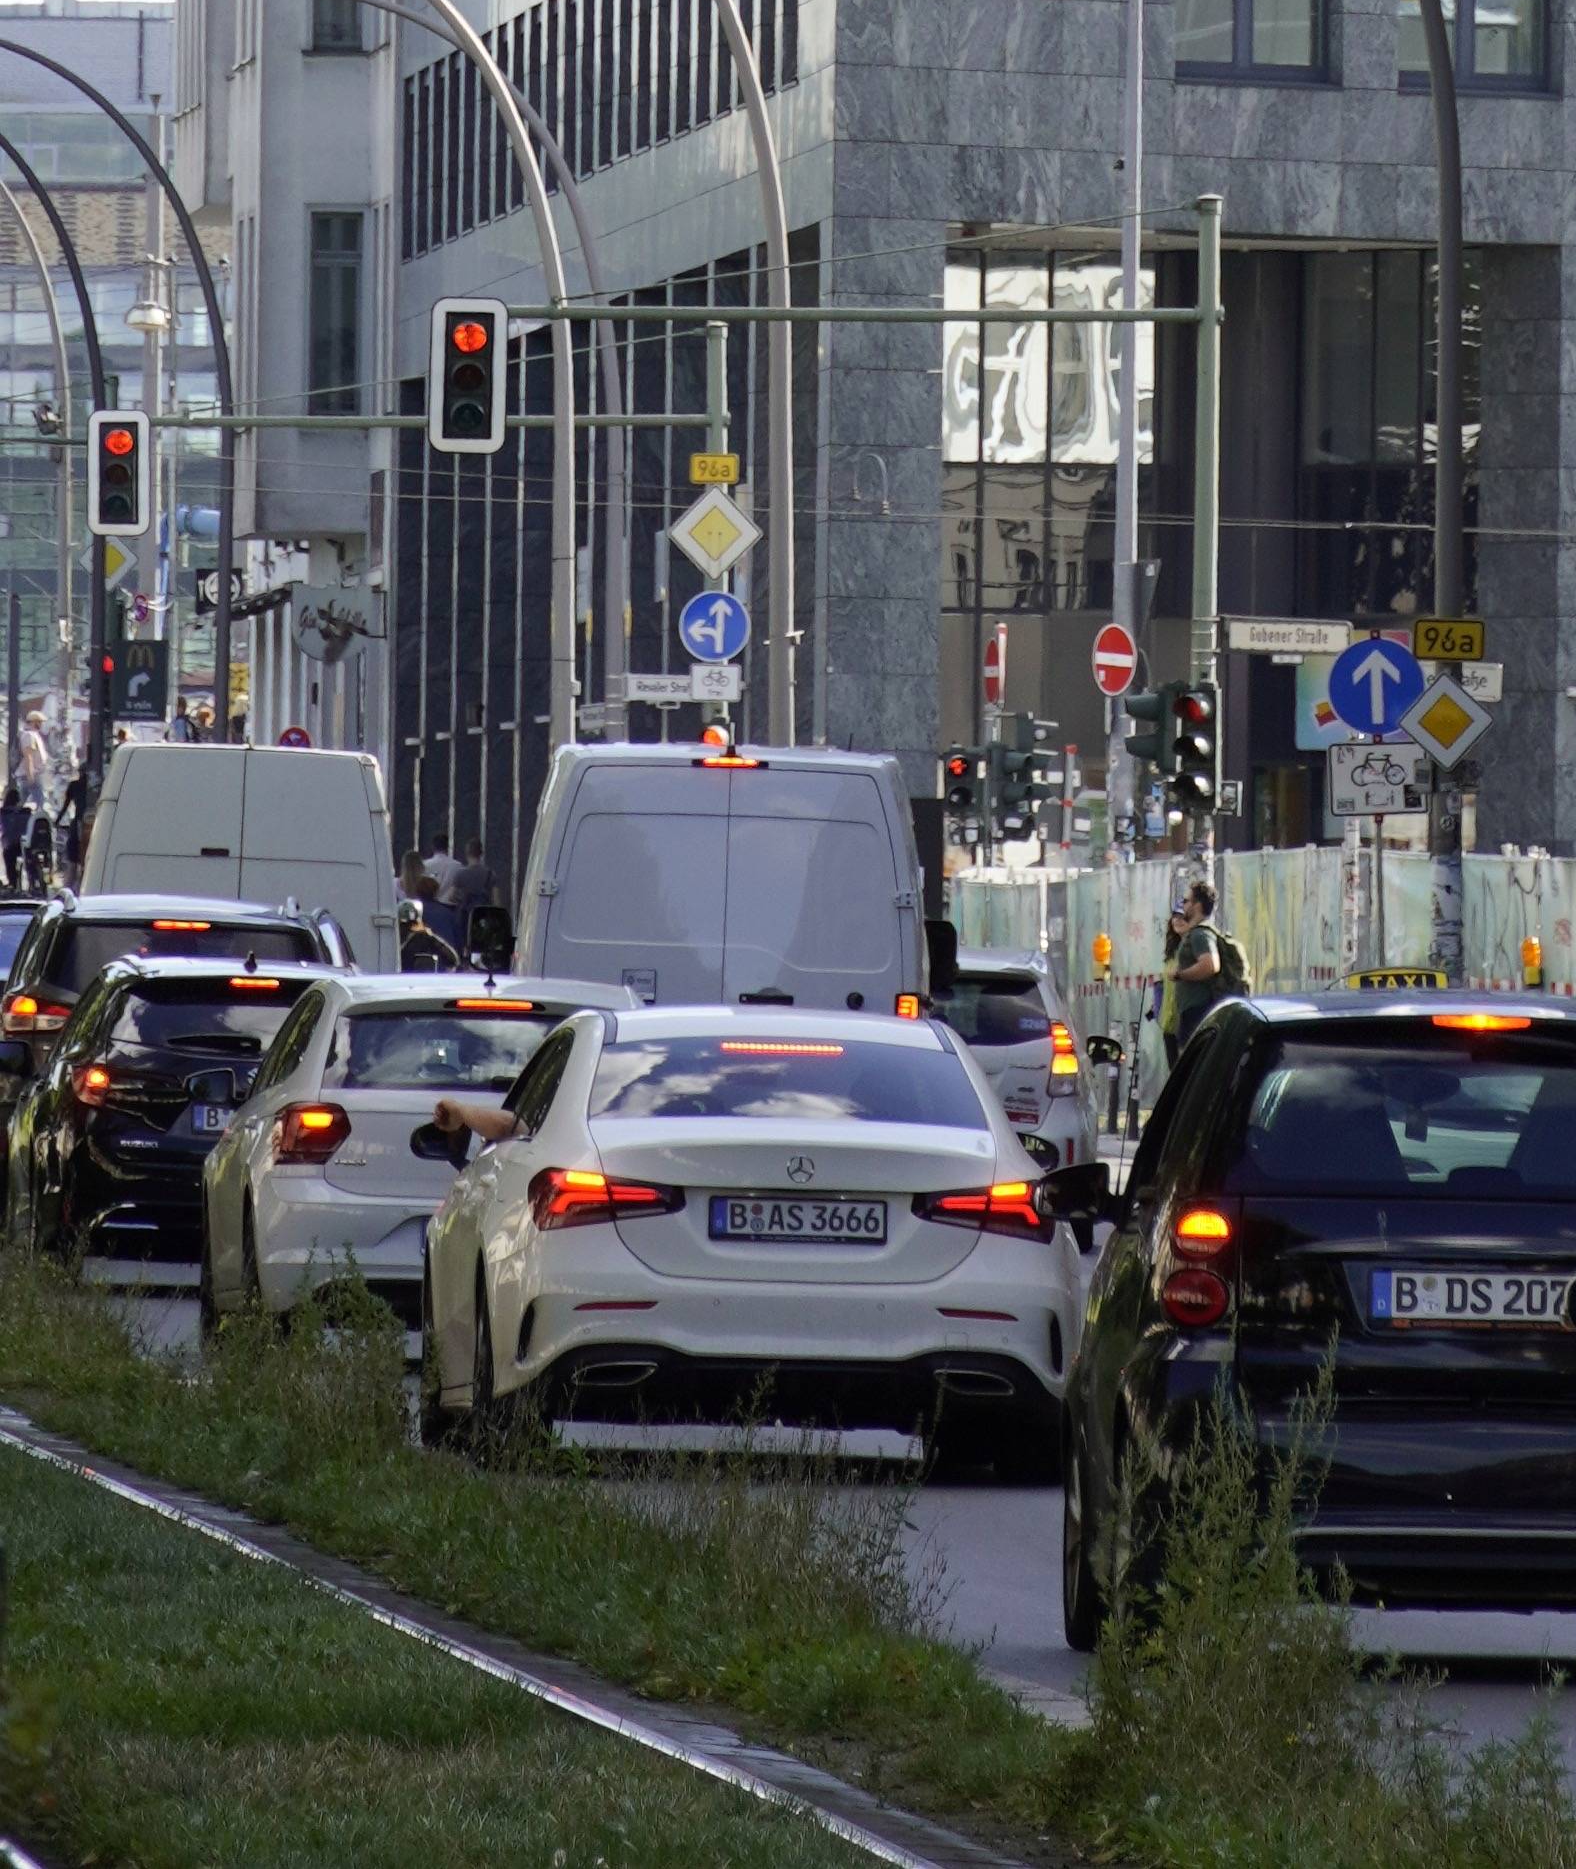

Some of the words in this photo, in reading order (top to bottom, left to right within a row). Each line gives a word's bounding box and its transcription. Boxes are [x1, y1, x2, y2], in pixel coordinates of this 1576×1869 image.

[698, 460, 730, 477] 96a
[1250, 626, 1293, 644] Gubener
[1296, 627, 1329, 644] Straße
[1424, 626, 1475, 653] 96a
[1368, 974, 1428, 990] TAXI
[206, 1107, 219, 1128] B
[730, 1203, 748, 1230] B
[768, 1204, 804, 1232] AS
[811, 1205, 880, 1234] 3666
[1396, 1276, 1419, 1313] B
[1445, 1277, 1493, 1315] DS
